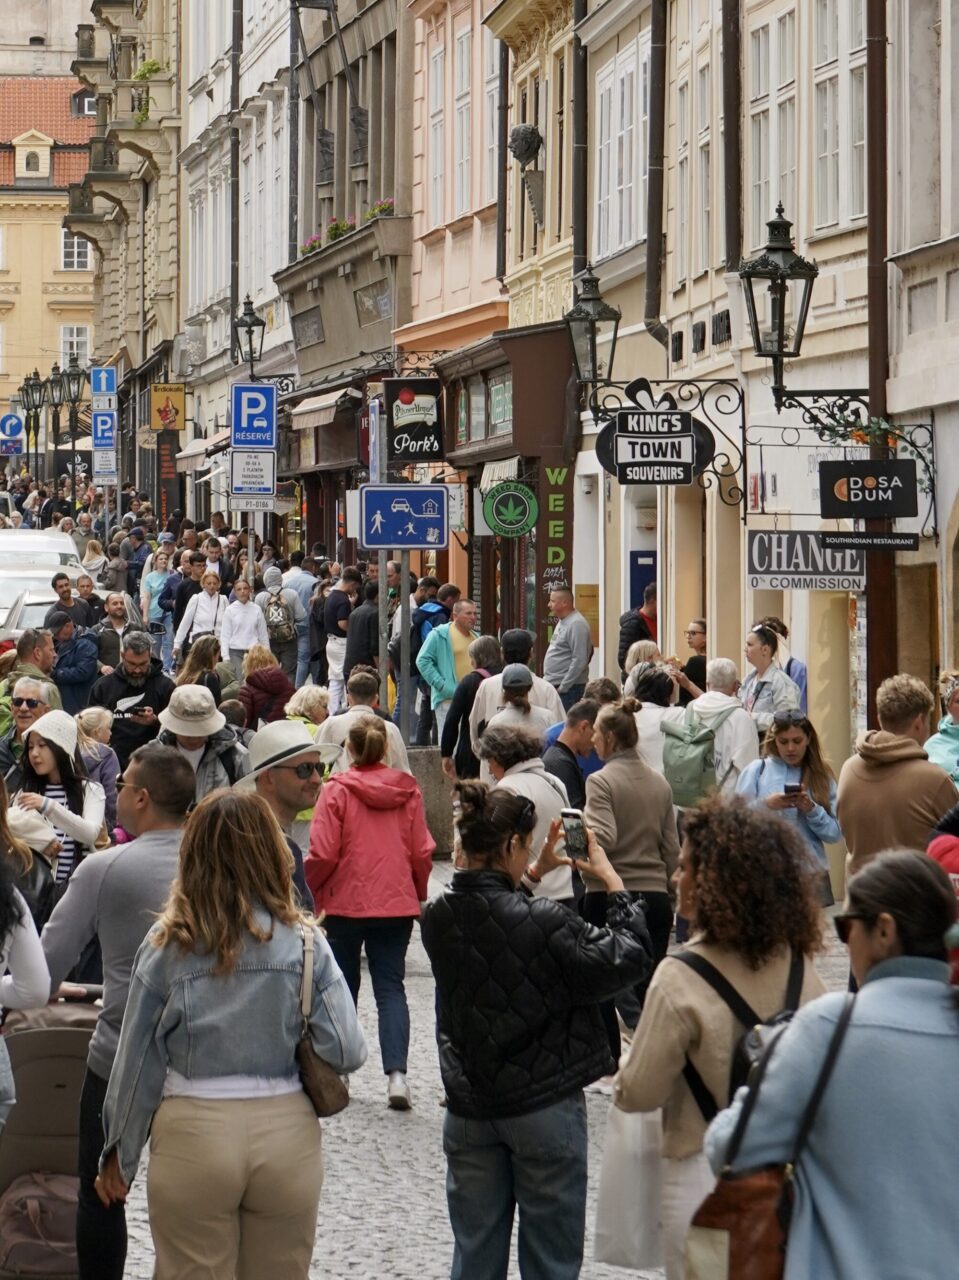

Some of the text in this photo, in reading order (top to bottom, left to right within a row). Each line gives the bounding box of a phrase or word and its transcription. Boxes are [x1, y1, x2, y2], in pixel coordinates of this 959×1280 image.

[241, 392, 267, 428] P
[97, 416, 112, 438] P
[628, 414, 682, 432] KING'S
[235, 430, 272, 440] RÉSERVÉ
[394, 433, 439, 454] Pork's
[628, 440, 682, 459] TOWN
[626, 466, 684, 480] SOUVENIRS
[850, 476, 902, 488] DOSA
[489, 484, 533, 500] WEED SHOP
[850, 490, 892, 502] DUM
[545, 468, 568, 564] WEED
[494, 523, 530, 536] COMPANY
[751, 576, 861, 590] 0% COMMISSION
